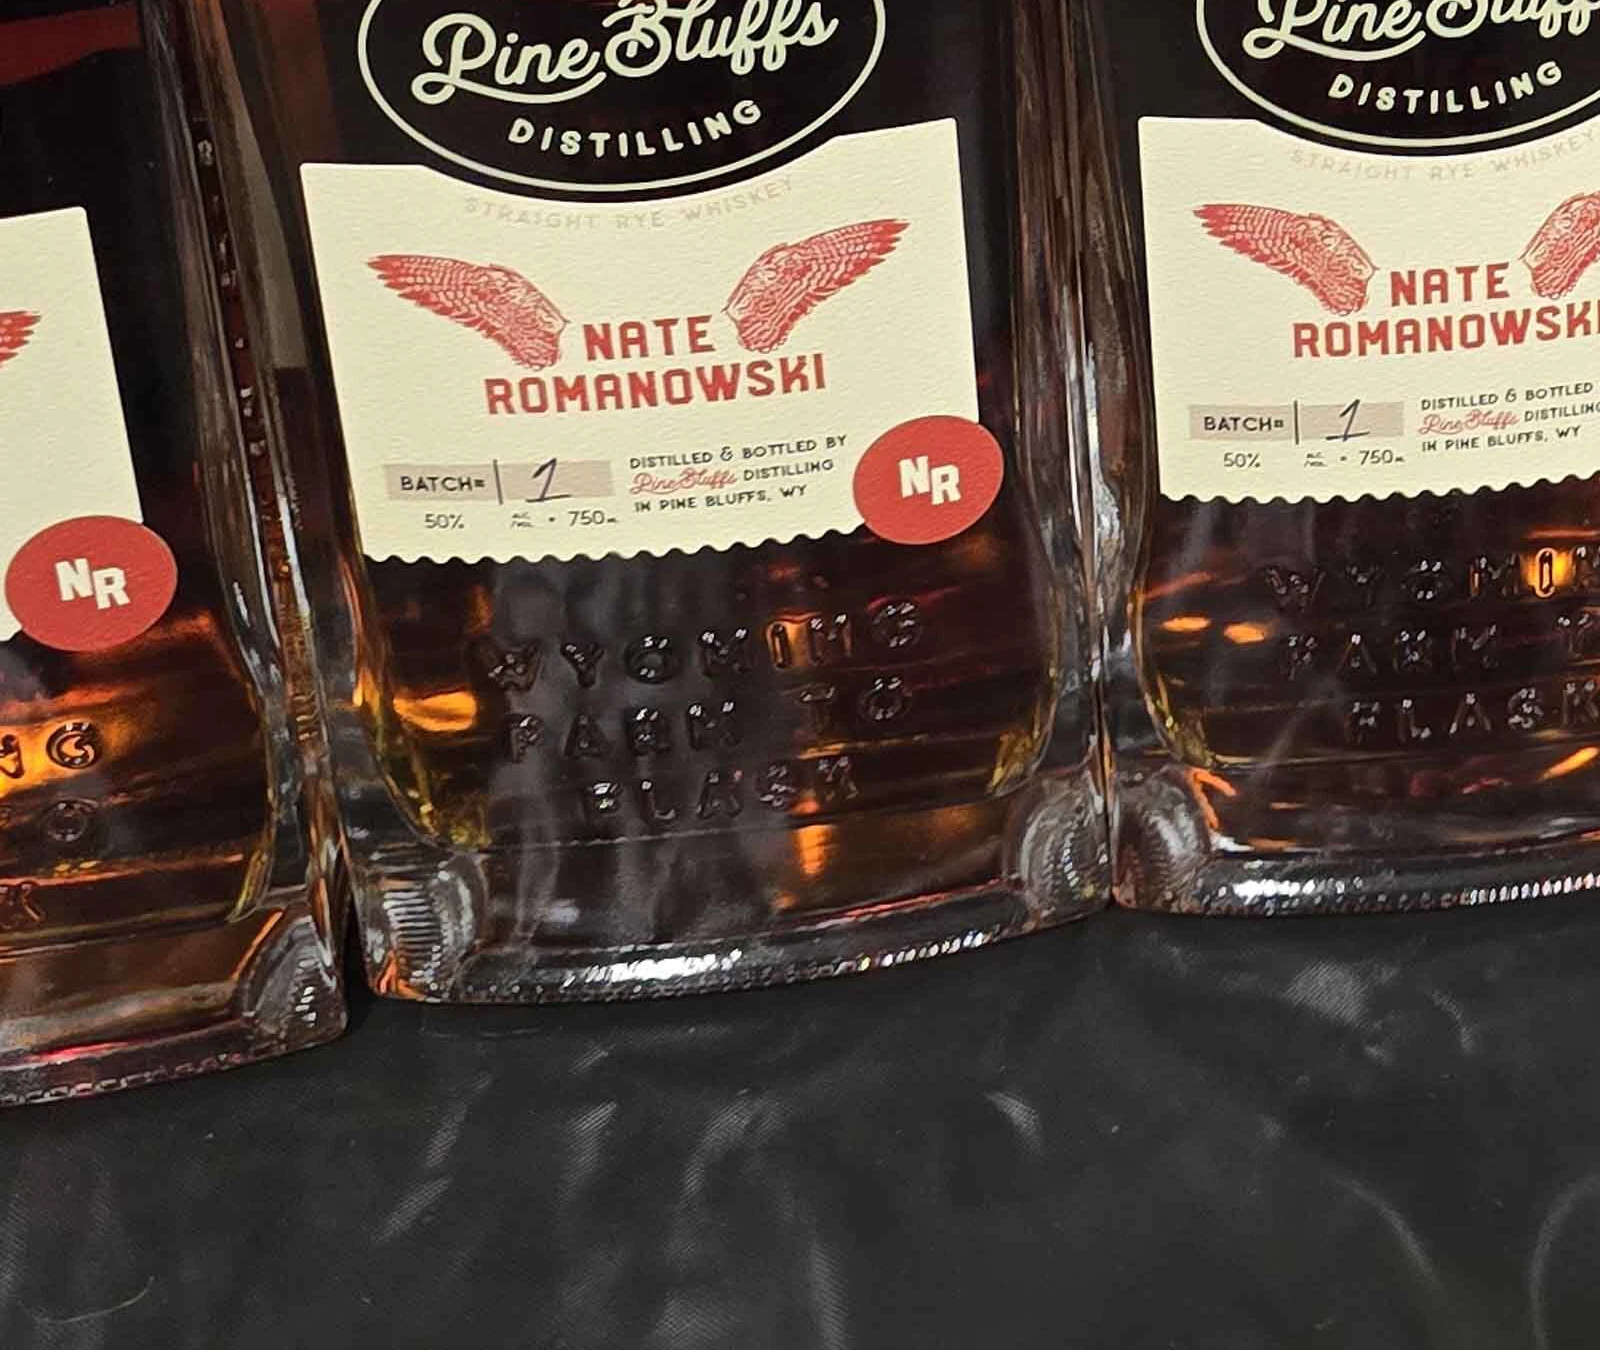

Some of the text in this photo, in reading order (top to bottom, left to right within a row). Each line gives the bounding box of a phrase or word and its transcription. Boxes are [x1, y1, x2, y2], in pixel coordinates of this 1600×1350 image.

[411, 12, 606, 106] Pine
[1328, 60, 1562, 114] DISTILLING
[508, 100, 762, 158] DISTILLING
[1290, 131, 1596, 180] STRAIGHT RYE WHISKEY
[464, 176, 794, 230] STRAIGHT RYE WHISKEY
[1390, 261, 1510, 307] NATE
[585, 315, 716, 363] NATE
[483, 352, 827, 416] ROMANOWSKI
[1421, 393, 1499, 411] DISTILLED
[1505, 388, 1517, 403] &
[1525, 382, 1594, 401] BOTTLED
[1326, 399, 1370, 441] 1
[1422, 426, 1582, 452] IN PINE BLUFFS, WY
[630, 434, 848, 470] DISTILLED & BOTTLED BY
[743, 459, 834, 481] DISTILLING
[1223, 452, 1261, 468] 50%
[525, 458, 572, 503] 1
[634, 484, 808, 513] IN PINE BLUFFS, WY
[898, 457, 962, 506] NR
[424, 513, 465, 530] 50%
[54, 558, 131, 610] NR
[1351, 677, 1600, 743] FLASK
